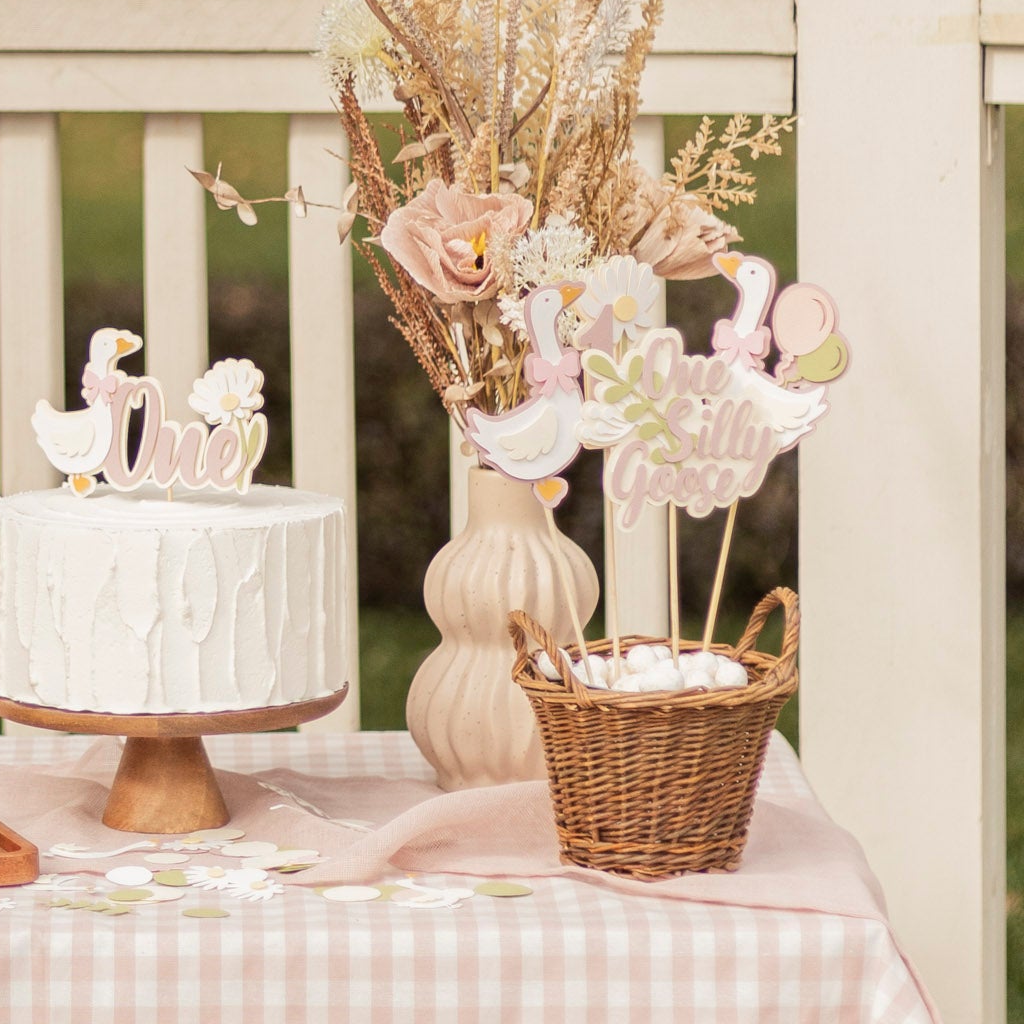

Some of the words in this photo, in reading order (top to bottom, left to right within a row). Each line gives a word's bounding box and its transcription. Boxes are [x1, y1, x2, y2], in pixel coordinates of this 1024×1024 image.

[643, 337, 731, 400] One
[105, 381, 248, 486] One
[664, 398, 774, 492] Silly
[614, 440, 740, 528] Goose
